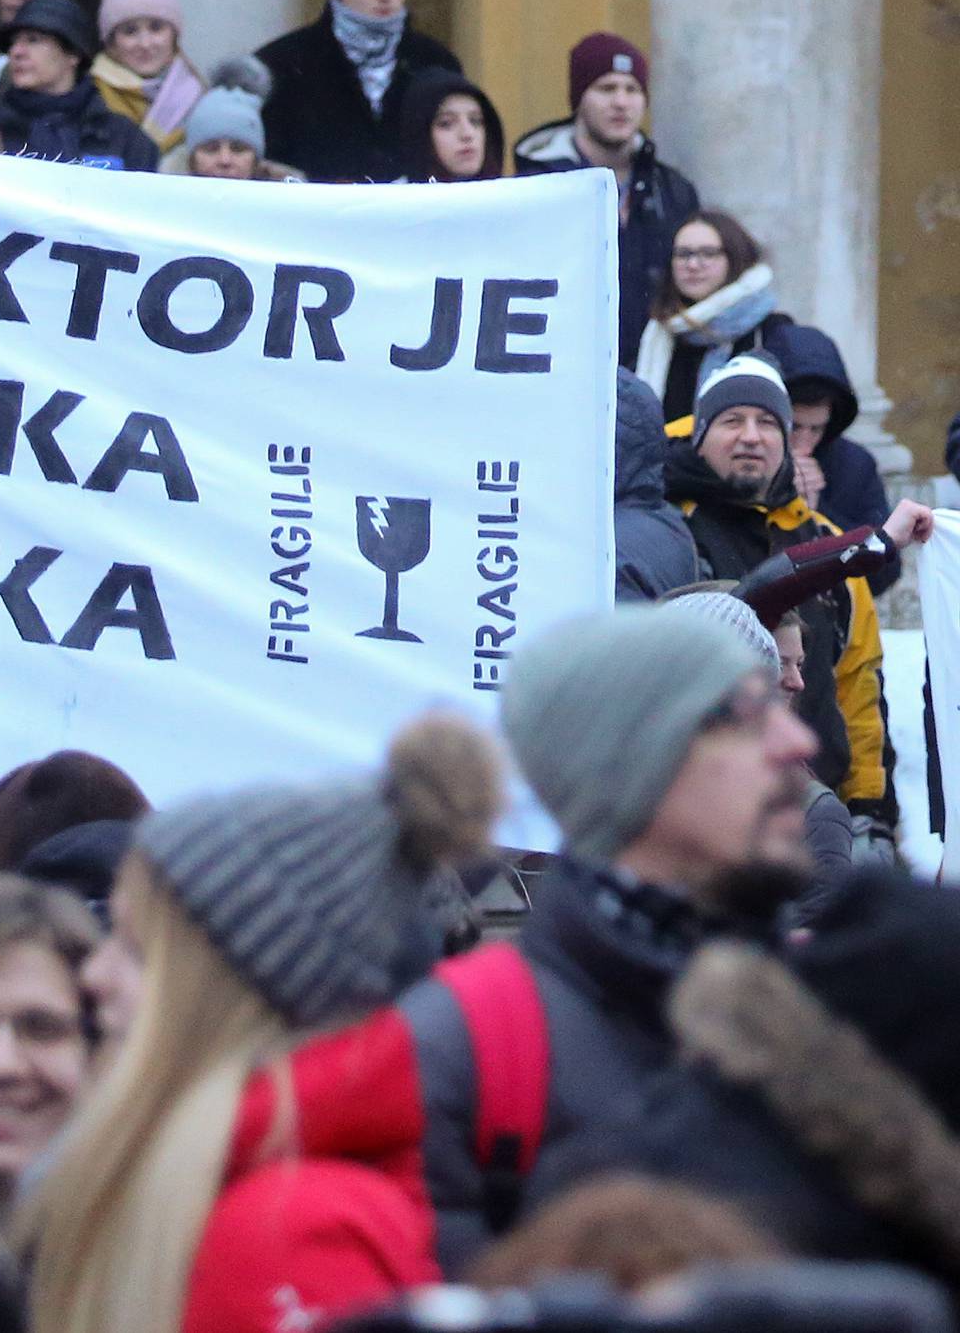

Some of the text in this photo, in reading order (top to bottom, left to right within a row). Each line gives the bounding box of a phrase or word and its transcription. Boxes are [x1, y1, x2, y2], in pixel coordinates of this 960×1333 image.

[389, 277, 559, 374] JE
[267, 443, 313, 664] FRAGILE
[473, 461, 520, 692] FRAGILE
